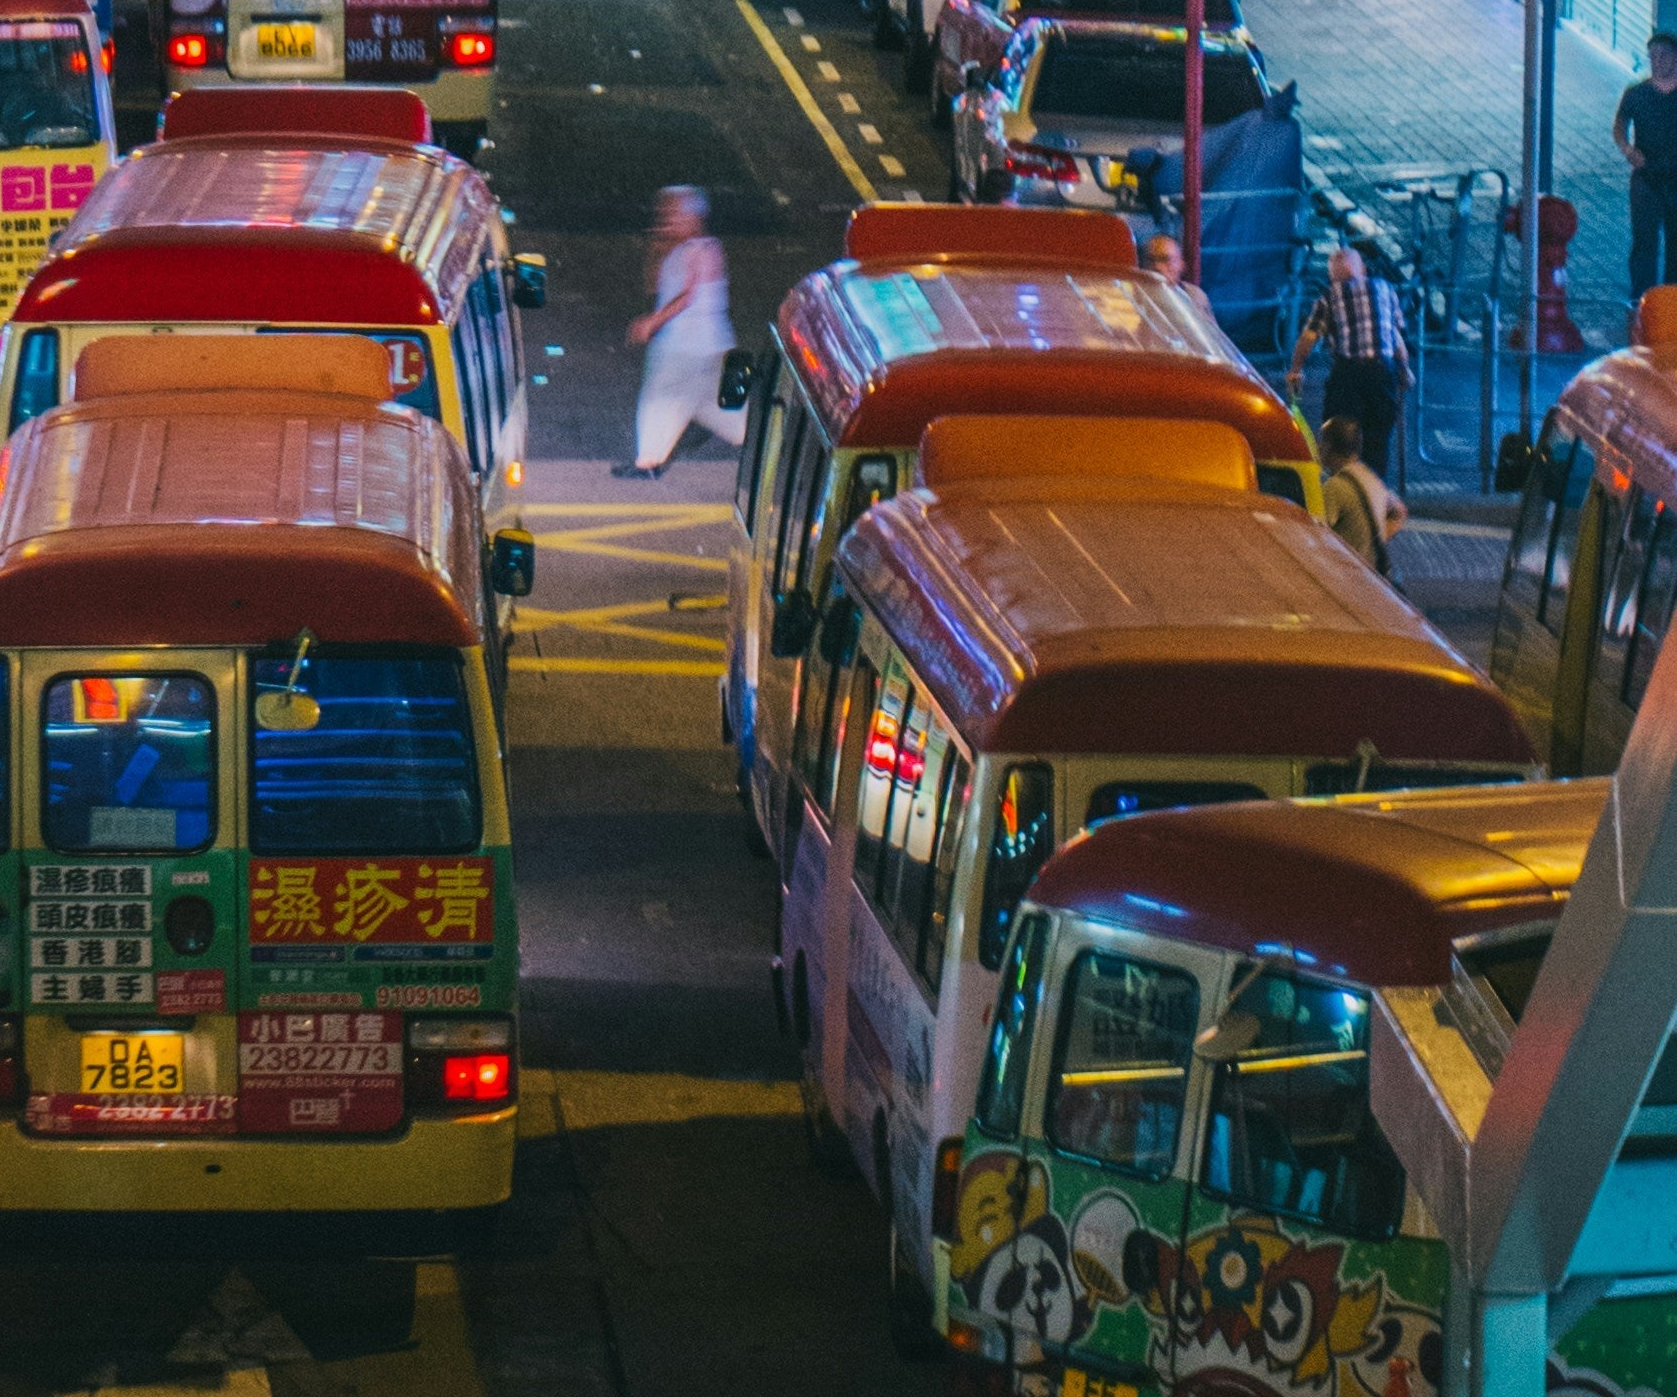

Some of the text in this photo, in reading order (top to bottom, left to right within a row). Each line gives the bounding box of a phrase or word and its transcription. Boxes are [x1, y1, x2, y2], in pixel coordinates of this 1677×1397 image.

[42, 975, 143, 1001] 主婦手
[376, 984, 482, 1007] 91091064
[251, 1013, 385, 1043] 小巴廣告
[109, 1038, 154, 1064] DA
[249, 1046, 390, 1072] 23822773
[85, 1064, 180, 1090] 7823
[170, 1094, 236, 1120] 2773
